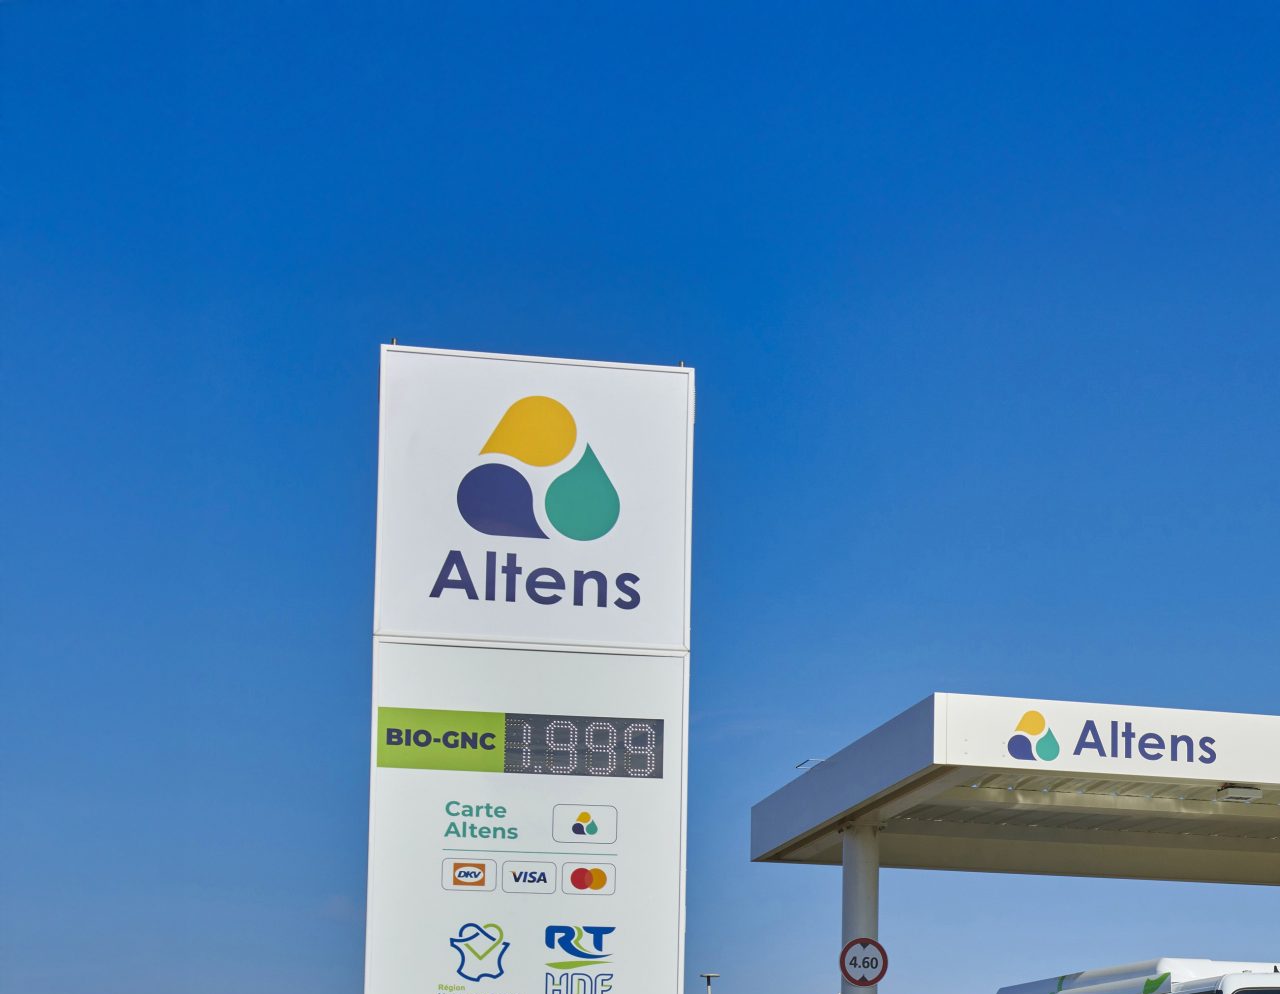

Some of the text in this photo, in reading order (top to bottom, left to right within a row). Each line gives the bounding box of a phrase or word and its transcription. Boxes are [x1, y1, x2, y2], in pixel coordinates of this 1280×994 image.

[429, 550, 641, 610] Altens
[386, 727, 496, 750] BIO-GNC
[1073, 719, 1217, 764] Altens
[445, 801, 507, 818] Carte
[444, 821, 518, 839] Altens
[457, 870, 482, 879] DKV
[509, 871, 547, 884] VISA
[849, 956, 879, 969] 4.60
[438, 984, 466, 992] Région
